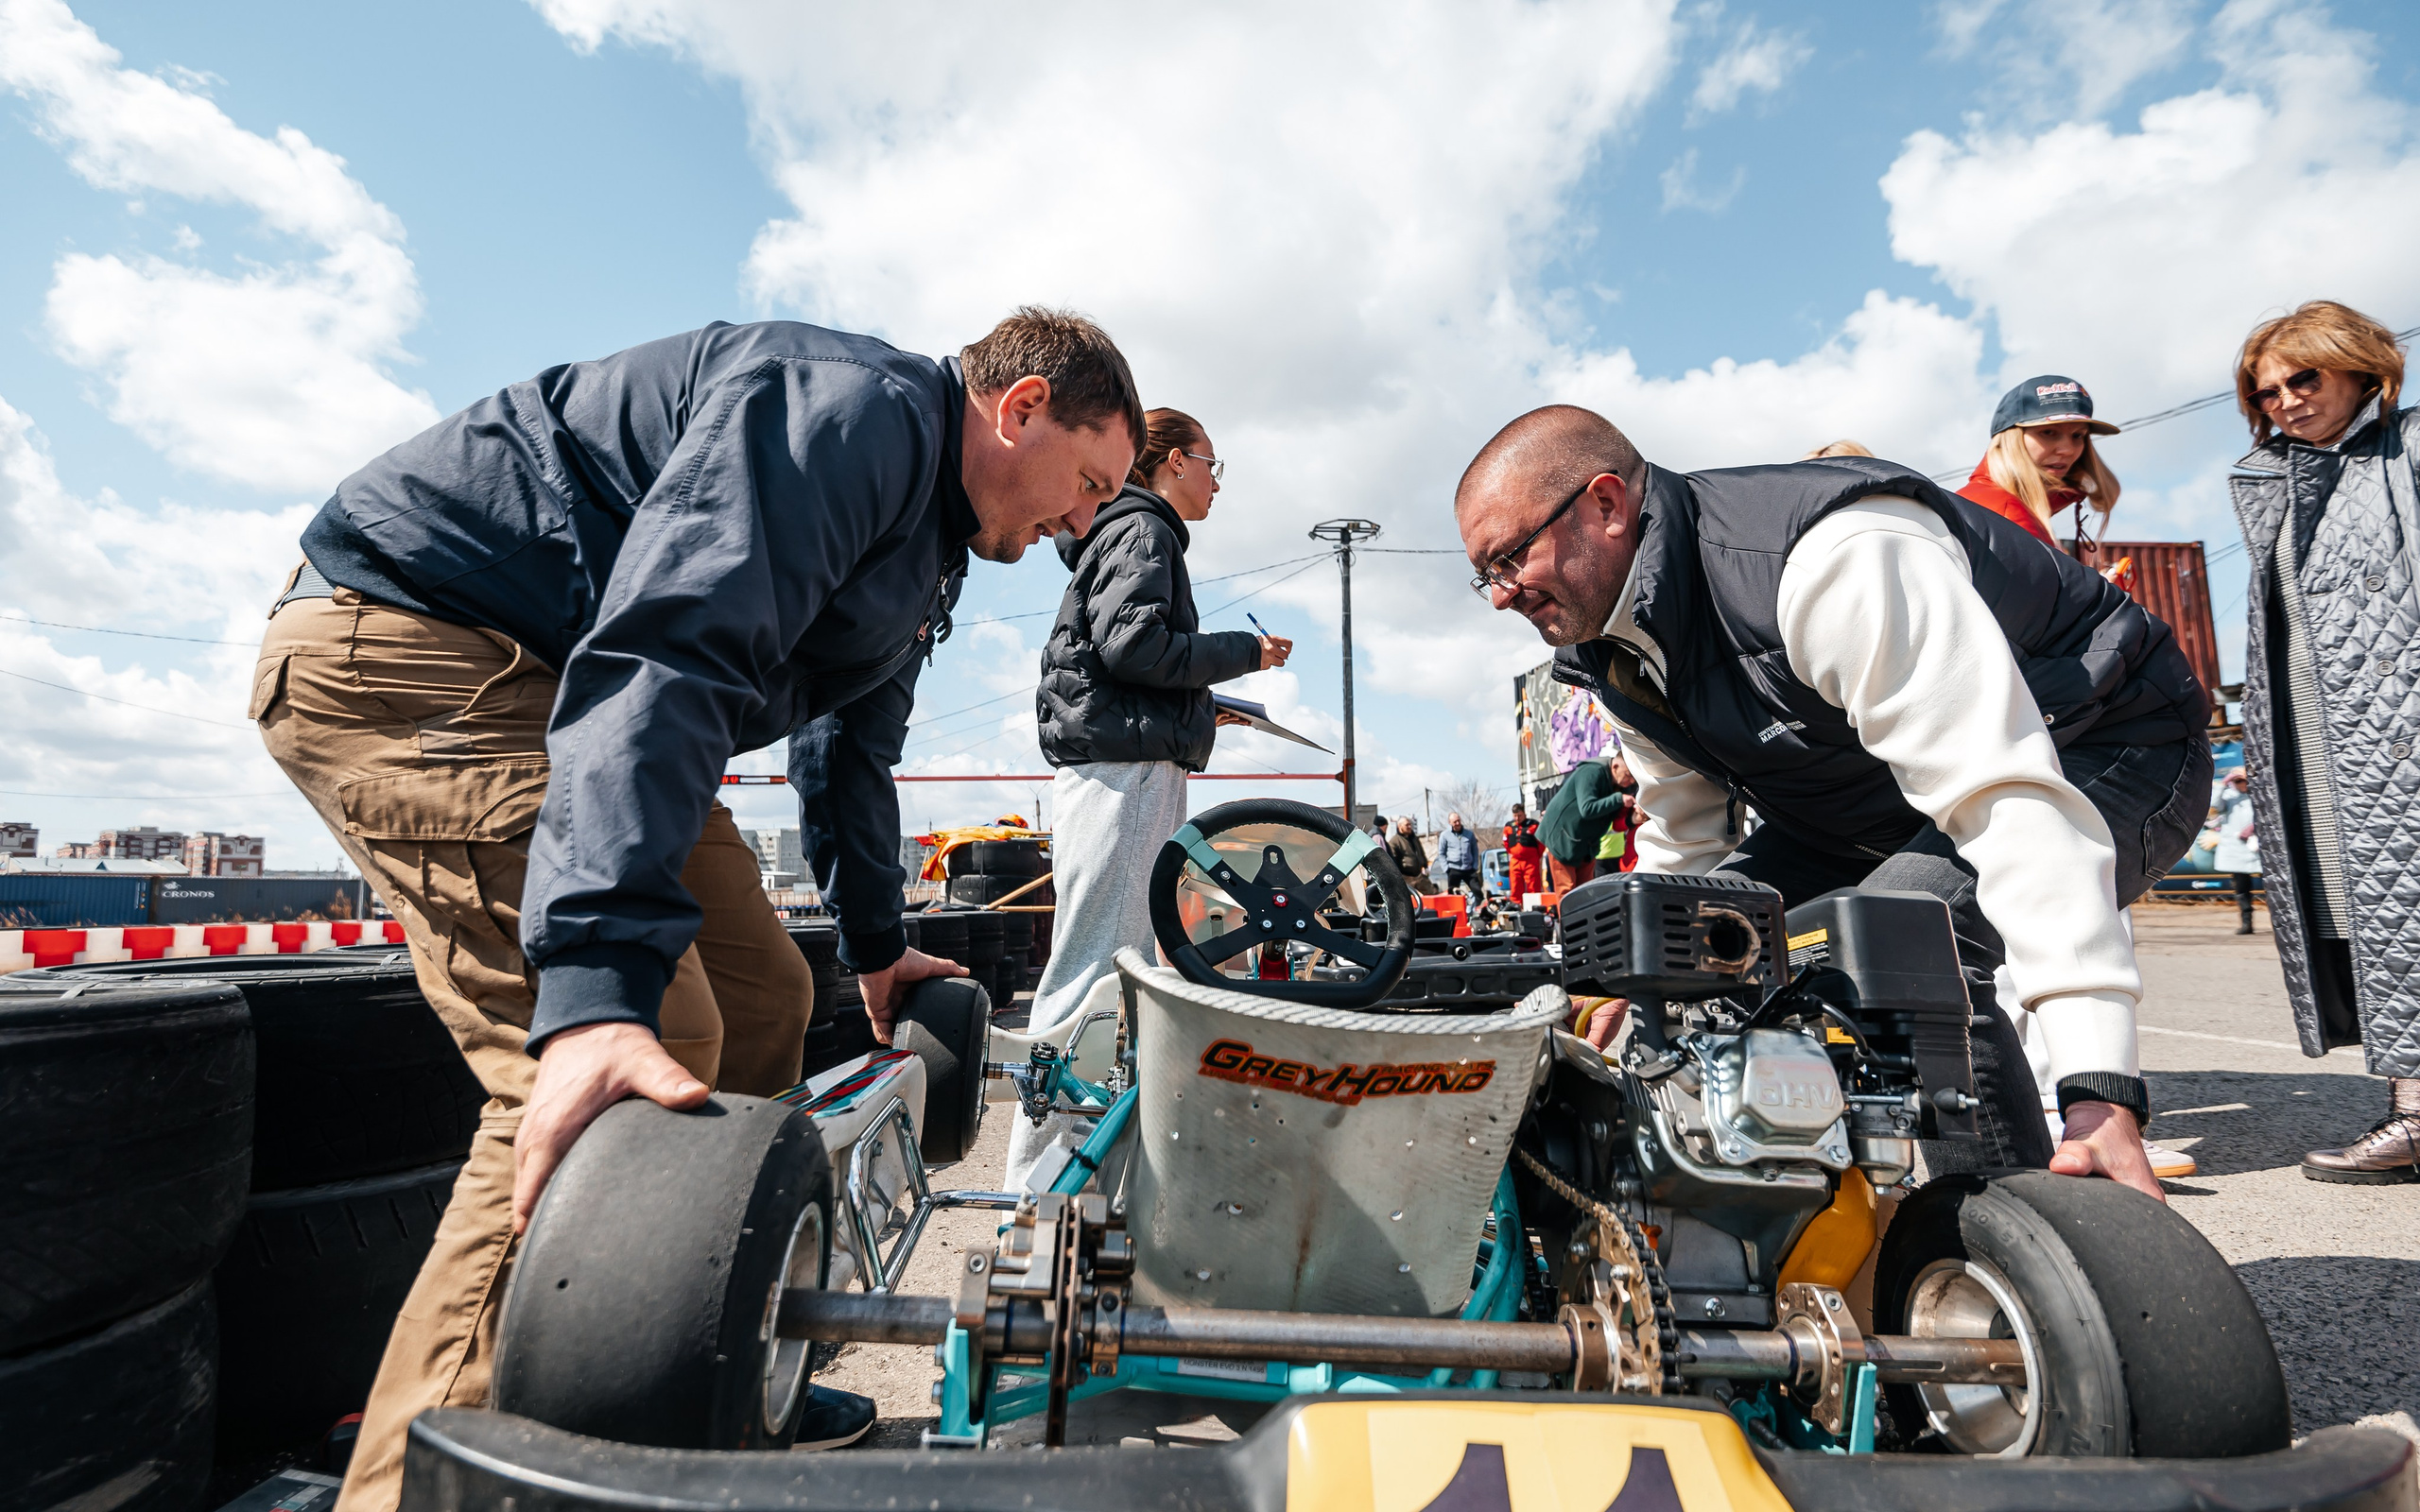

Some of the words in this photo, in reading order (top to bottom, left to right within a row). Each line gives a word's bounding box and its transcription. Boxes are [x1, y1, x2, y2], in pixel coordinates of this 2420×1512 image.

[1201, 1040, 1494, 1097] GREYHOUND
[1757, 1082, 1838, 1109] OHV
[1184, 1359, 1219, 1368] MONSTER
[1219, 1362, 1235, 1370] EVO
